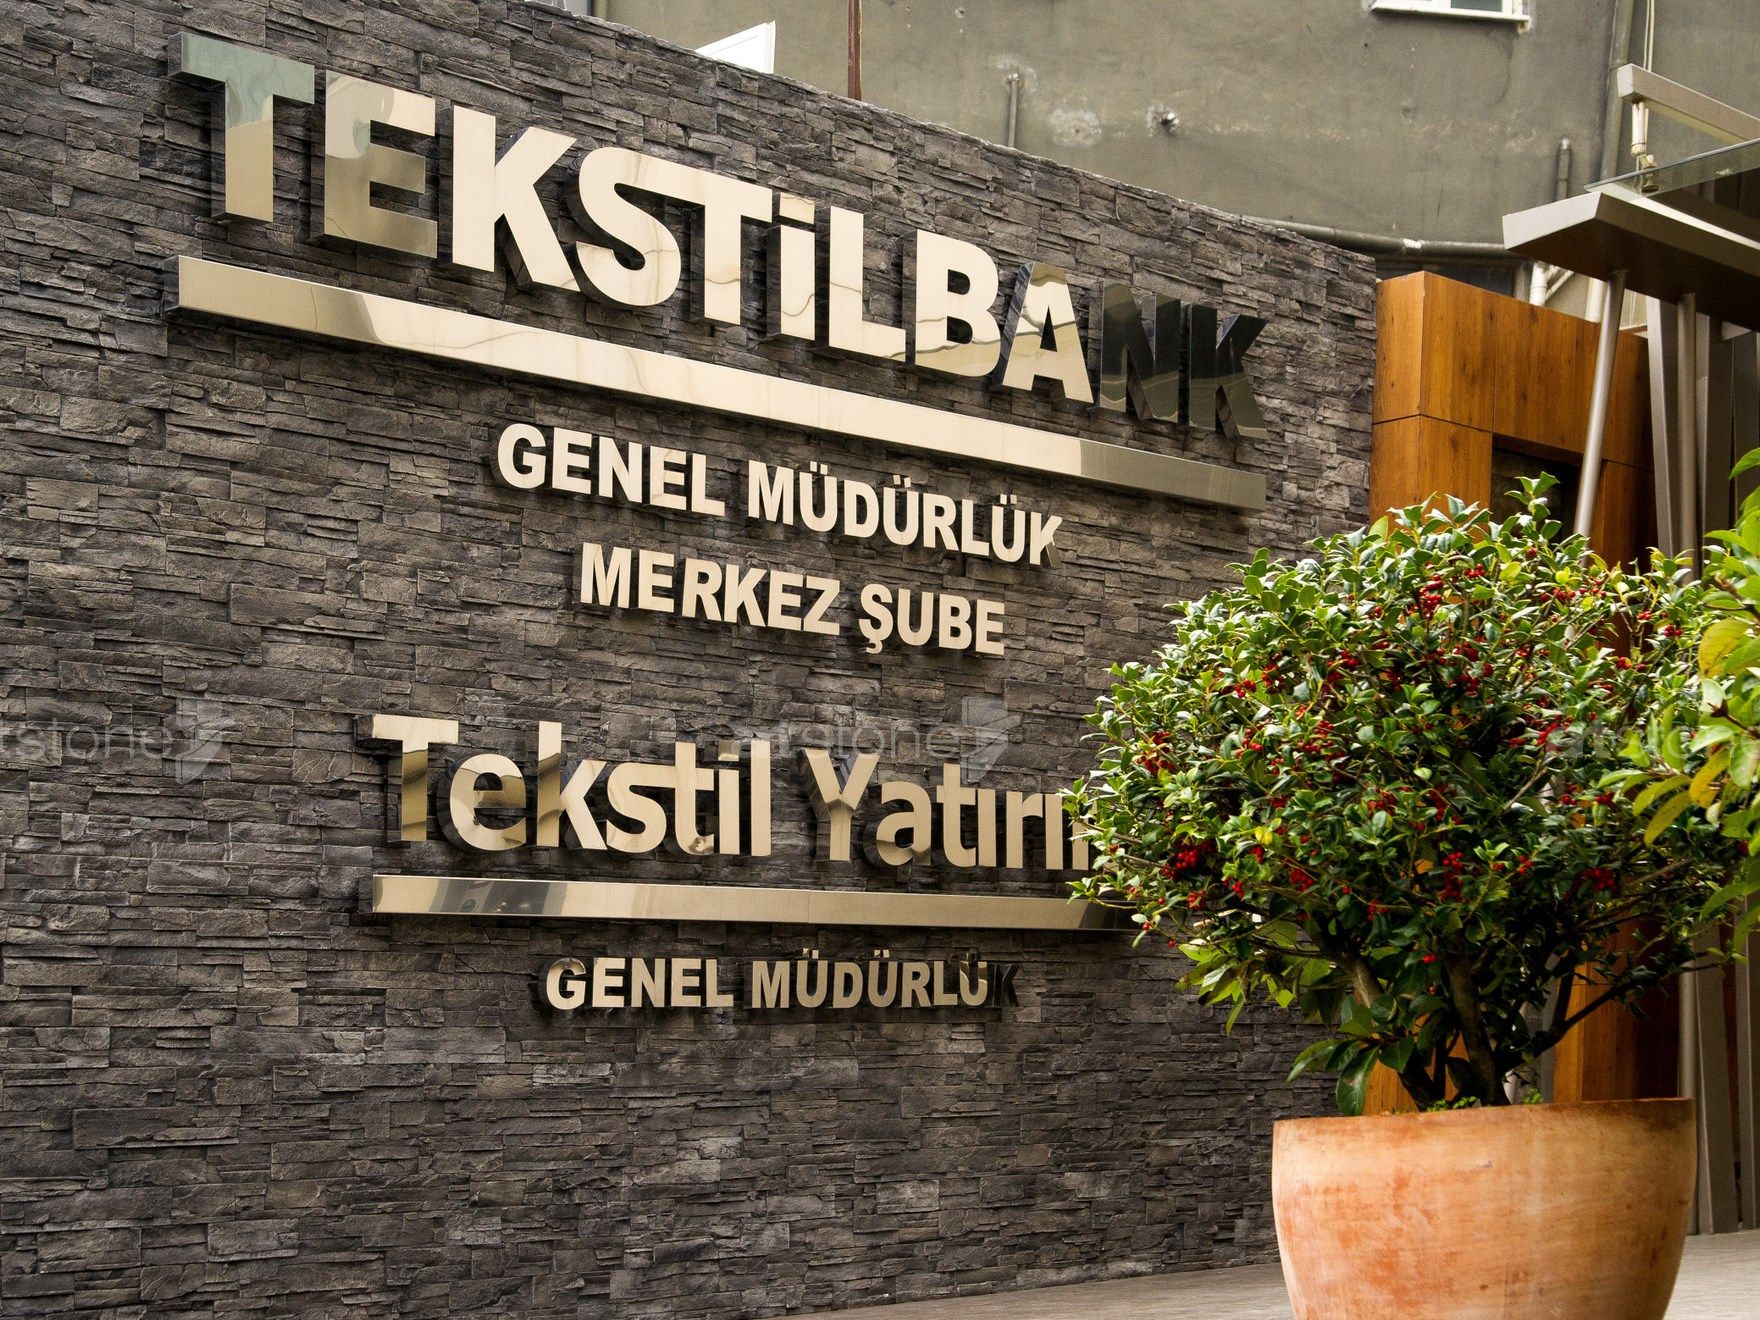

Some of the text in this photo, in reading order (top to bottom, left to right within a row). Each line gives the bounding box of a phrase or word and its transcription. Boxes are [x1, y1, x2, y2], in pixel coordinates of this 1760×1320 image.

[497, 423, 1063, 568] GENEL MÜDÜRLÜK
[579, 542, 1006, 656] MERKEZ ŞUBE
[370, 713, 773, 857] Tekstil
[545, 947, 1020, 1011] GENEL MÜDÜRLÜK
